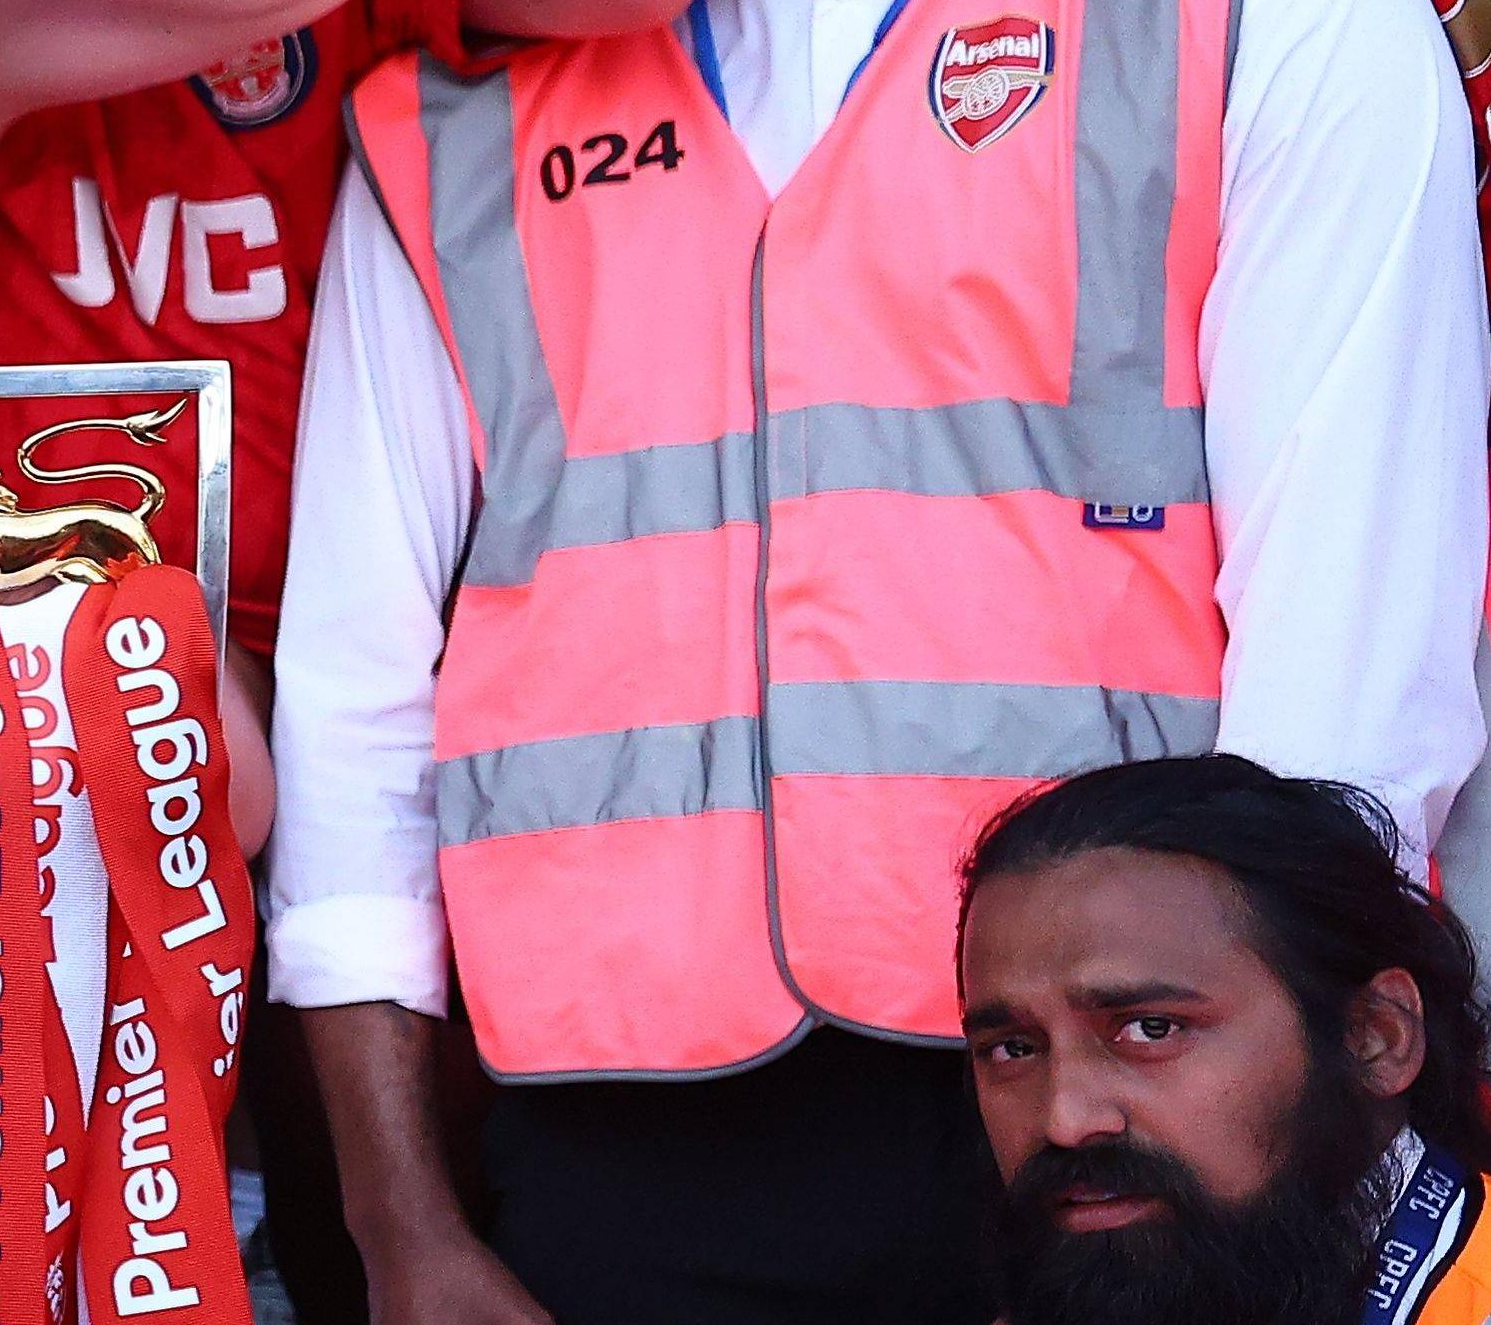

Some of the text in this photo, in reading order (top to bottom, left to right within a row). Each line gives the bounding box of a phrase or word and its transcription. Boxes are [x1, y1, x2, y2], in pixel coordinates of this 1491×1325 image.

[946, 32, 1040, 67] Arsenal
[540, 120, 685, 203] 024
[51, 177, 286, 325] JVC
[8, 641, 85, 965] ague
[104, 612, 227, 953] League
[1409, 1164, 1455, 1222] CPFC
[1367, 1238, 1418, 1311] CPFC
